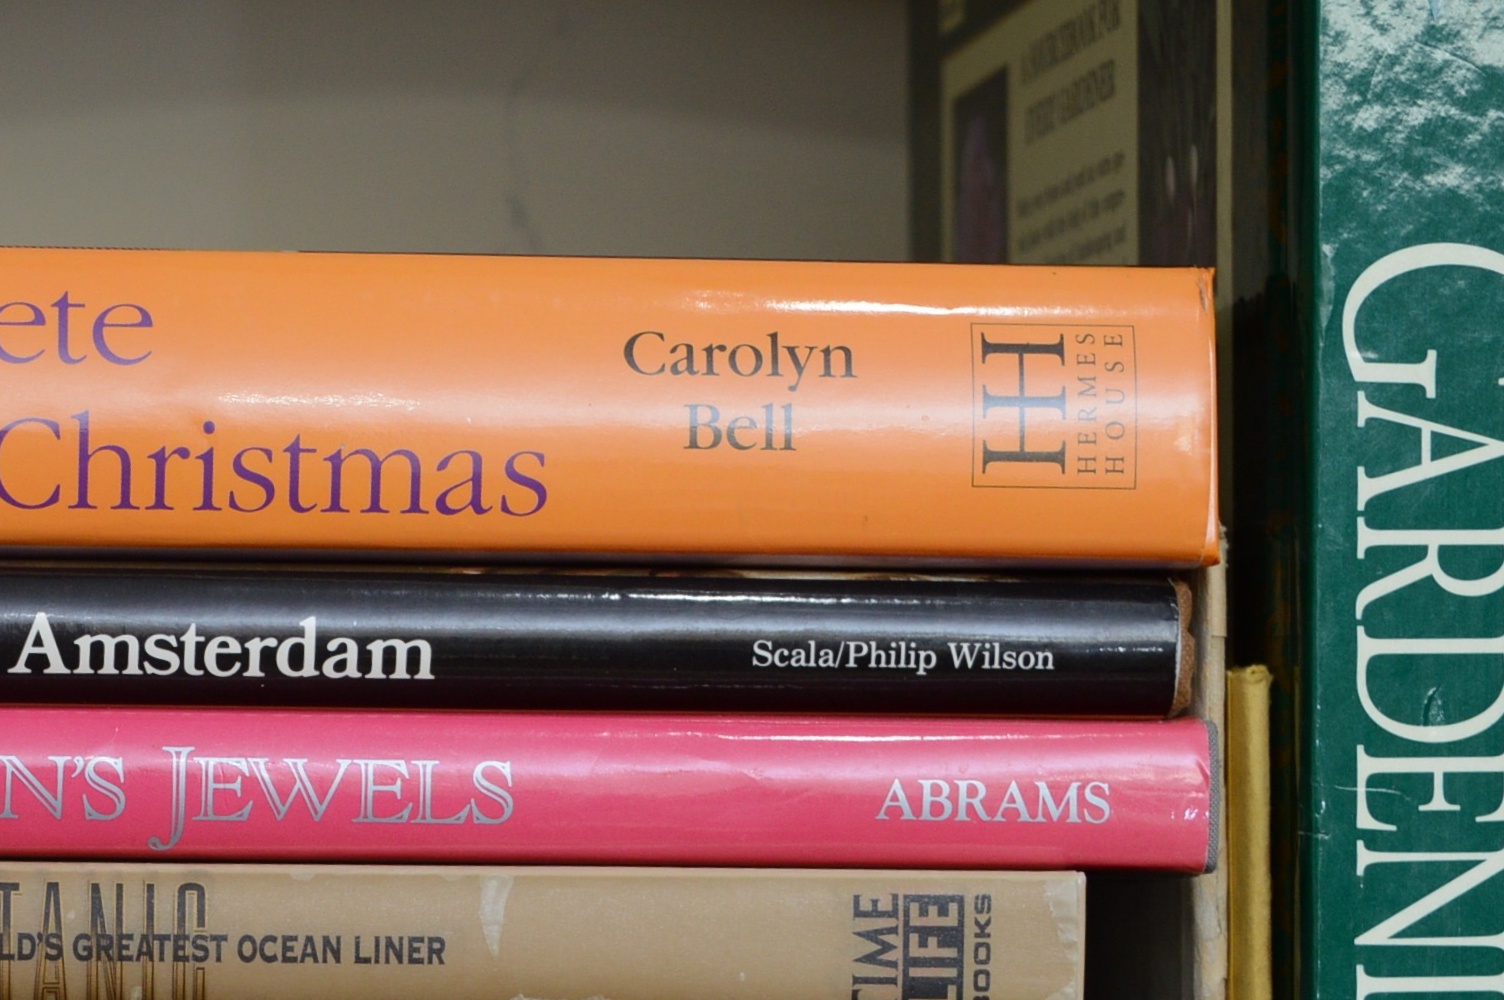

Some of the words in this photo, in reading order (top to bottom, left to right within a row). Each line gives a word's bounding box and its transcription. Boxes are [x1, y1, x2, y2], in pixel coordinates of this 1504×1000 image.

[622, 330, 858, 392] Carolyn
[683, 402, 797, 452] Bell
[1076, 331, 1096, 476] HERMES
[1104, 332, 1125, 476] HOUSE
[8, 612, 435, 681] Amsterdam
[752, 638, 937, 675] Scala/Philip
[947, 641, 1055, 671] Wilson
[147, 745, 514, 851] JEWELS
[874, 779, 1113, 825] ABRAMS
[72, 932, 229, 963] GREATEST
[237, 934, 343, 965] OCEAN
[354, 935, 447, 966] LINER
